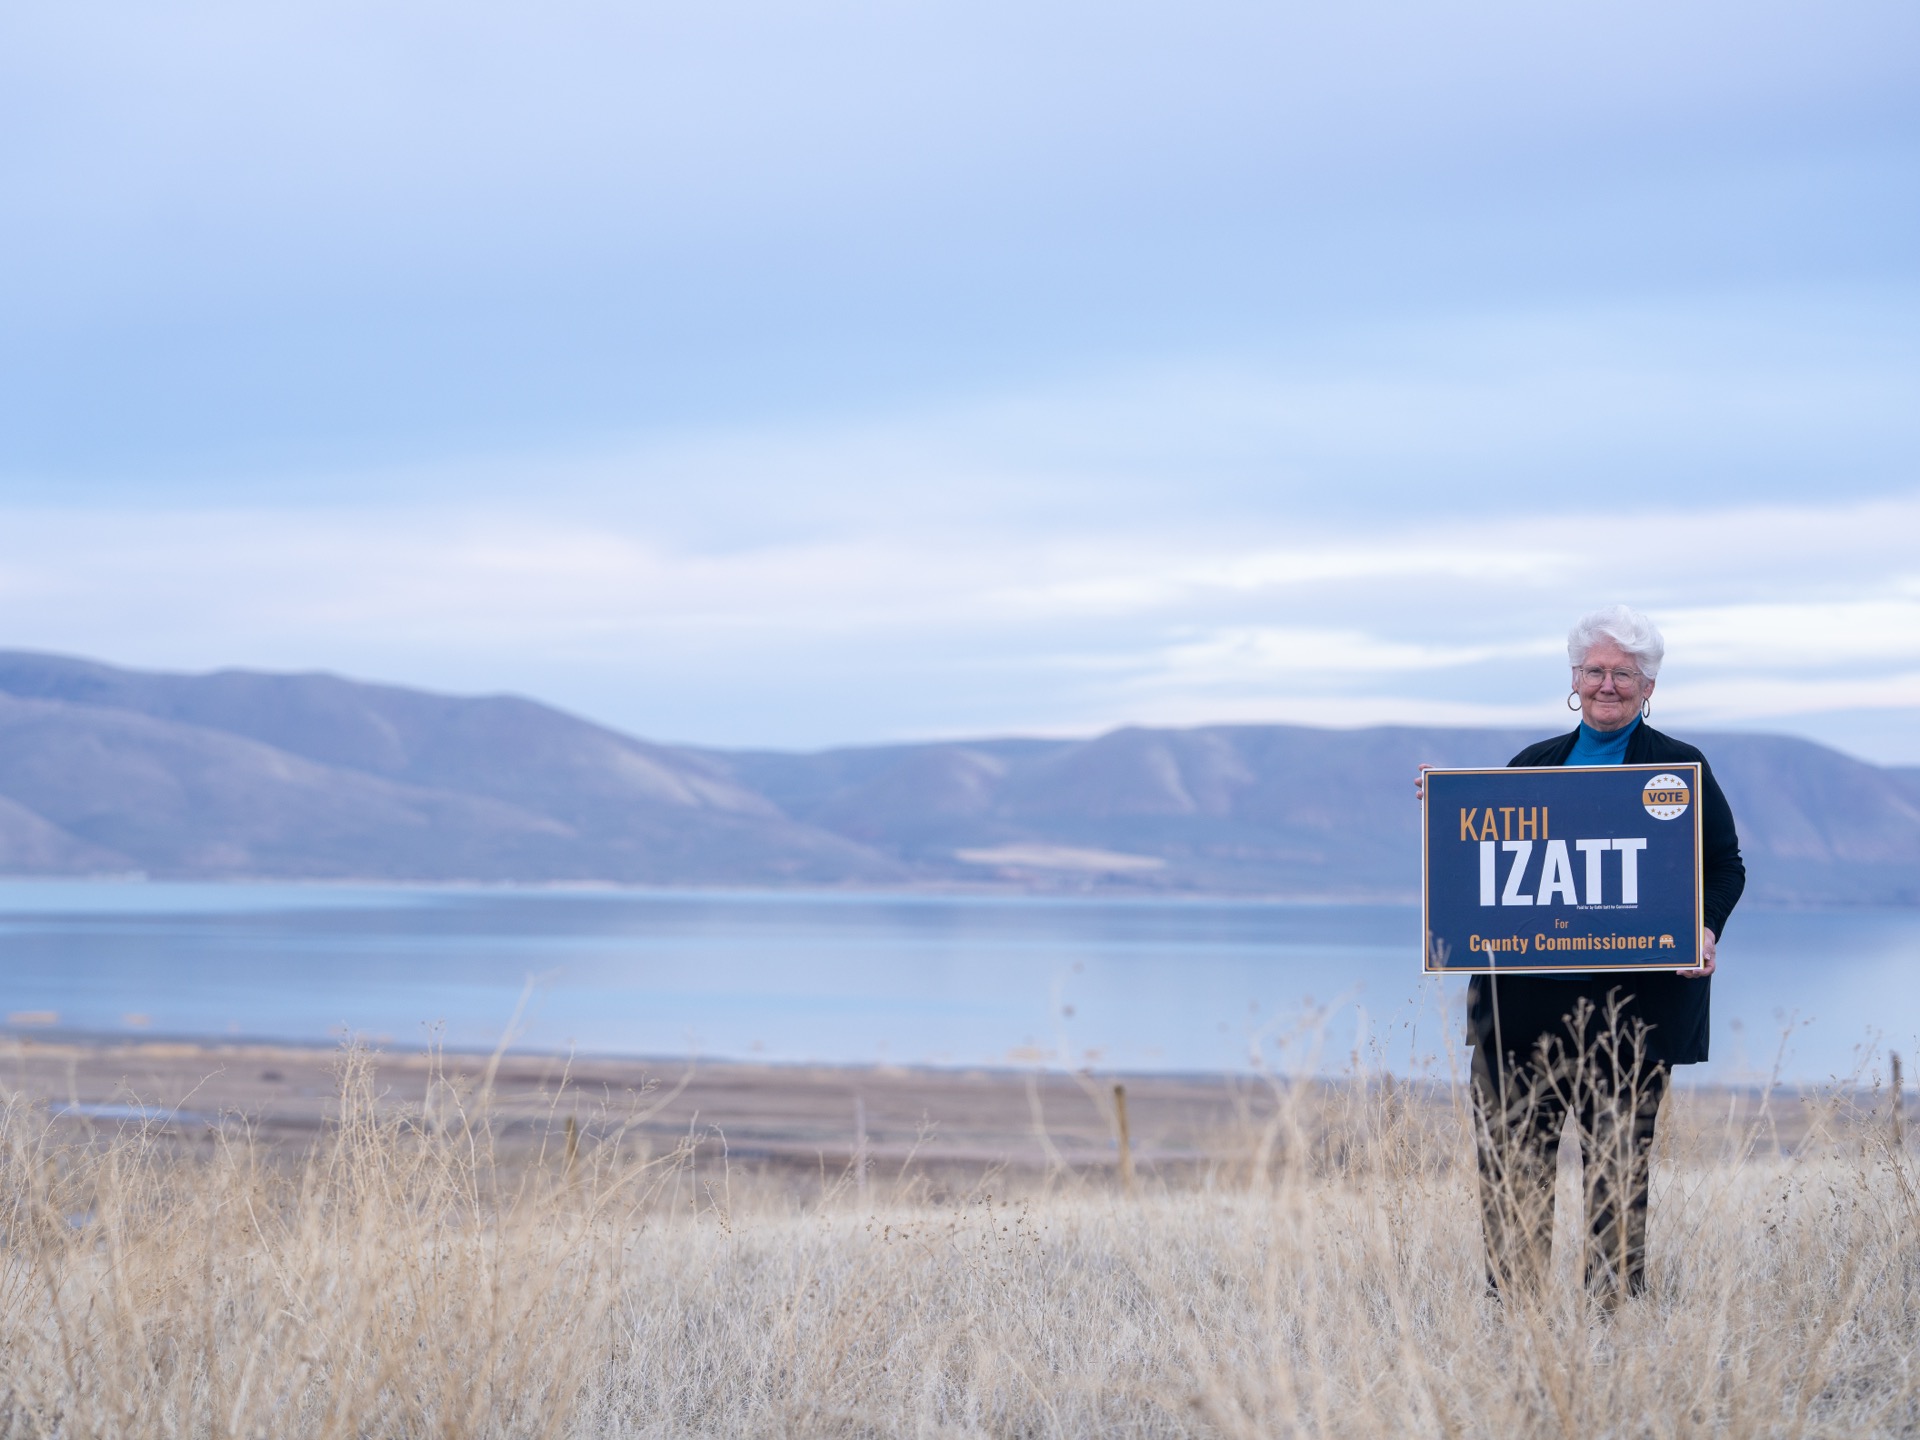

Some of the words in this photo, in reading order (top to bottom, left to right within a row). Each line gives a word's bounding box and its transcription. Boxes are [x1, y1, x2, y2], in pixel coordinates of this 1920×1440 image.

[1648, 791, 1684, 802] VOTE
[1460, 806, 1549, 842] KATHI
[1479, 837, 1647, 906] IZATT
[1554, 918, 1569, 929] For
[1469, 934, 1529, 954] County
[1535, 932, 1656, 951] Commissioner
